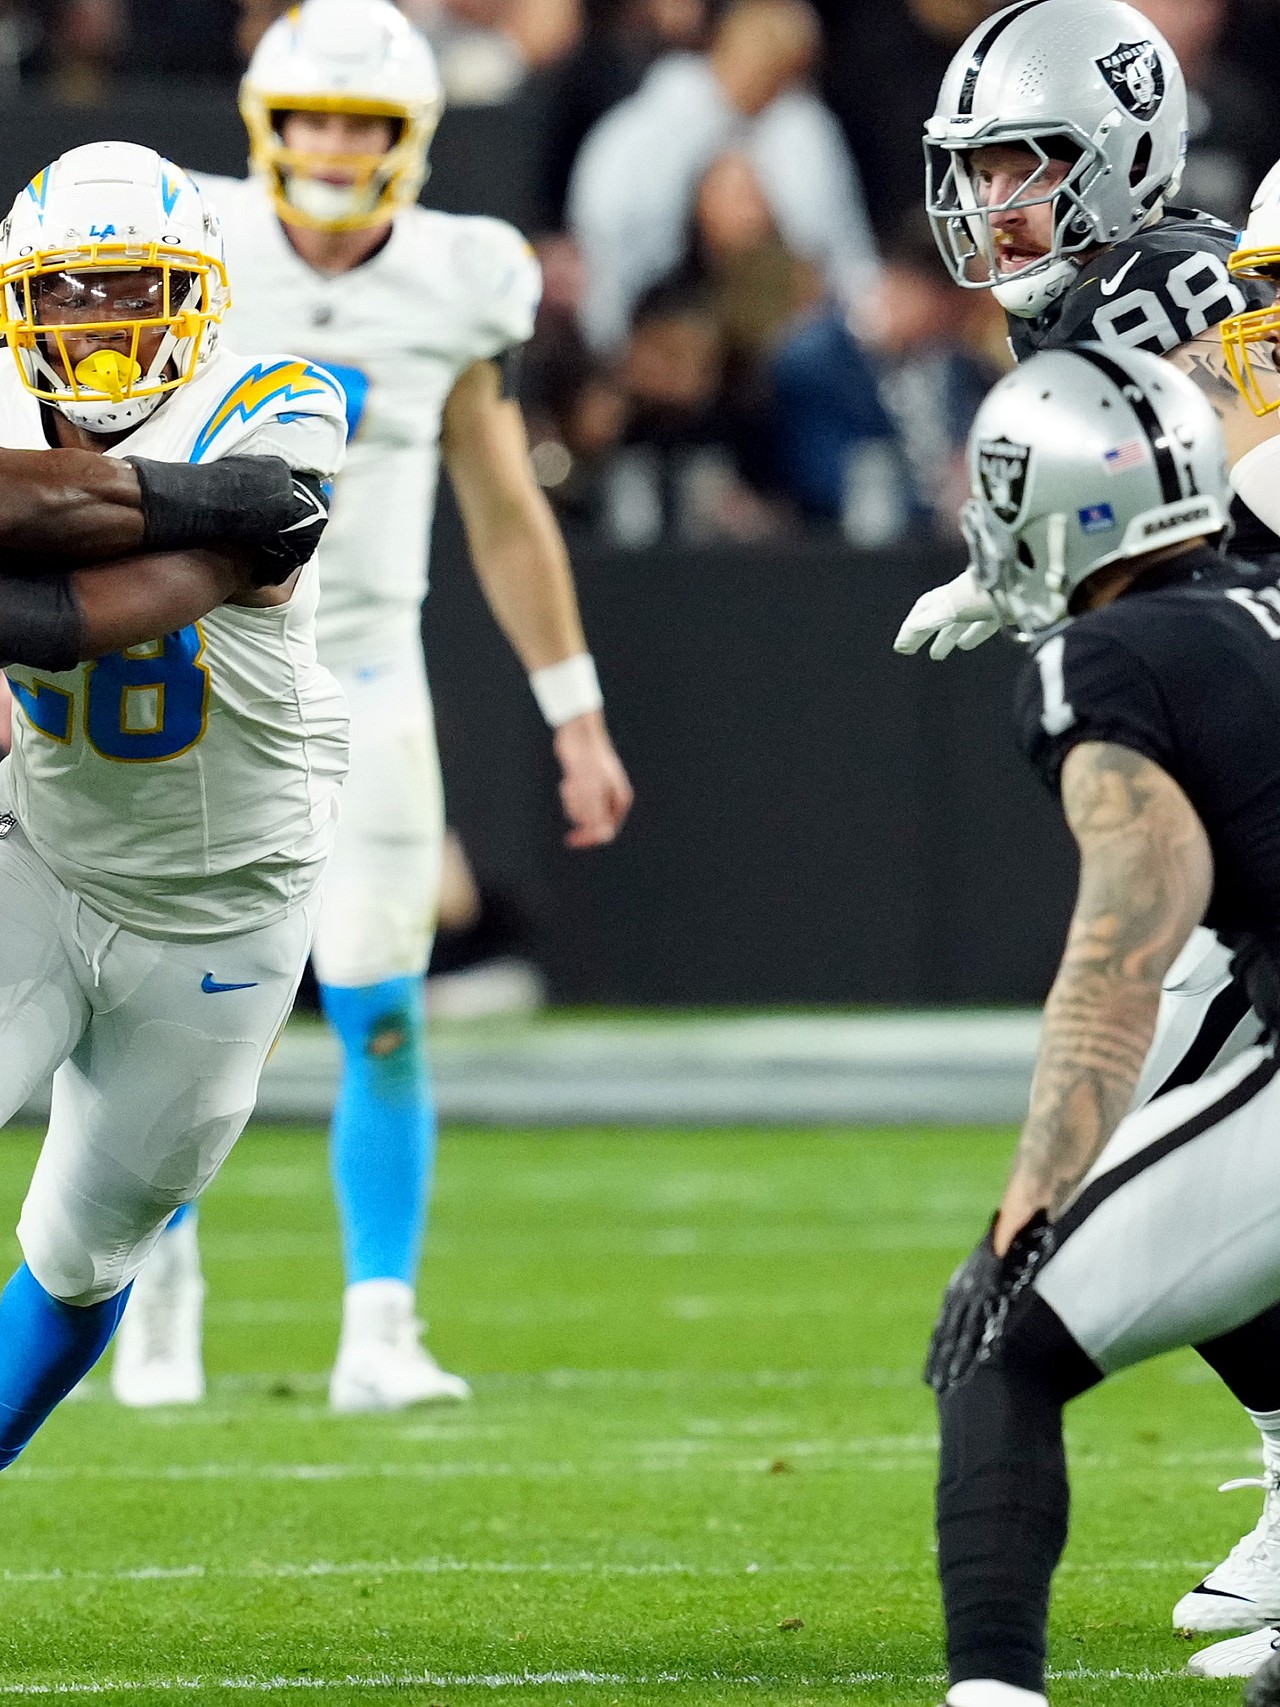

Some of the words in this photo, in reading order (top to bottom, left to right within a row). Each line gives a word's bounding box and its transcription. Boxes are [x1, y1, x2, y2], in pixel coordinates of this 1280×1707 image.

[89, 224, 116, 242] LA
[1091, 250, 1247, 357] 98
[1036, 638, 1075, 736] 1
